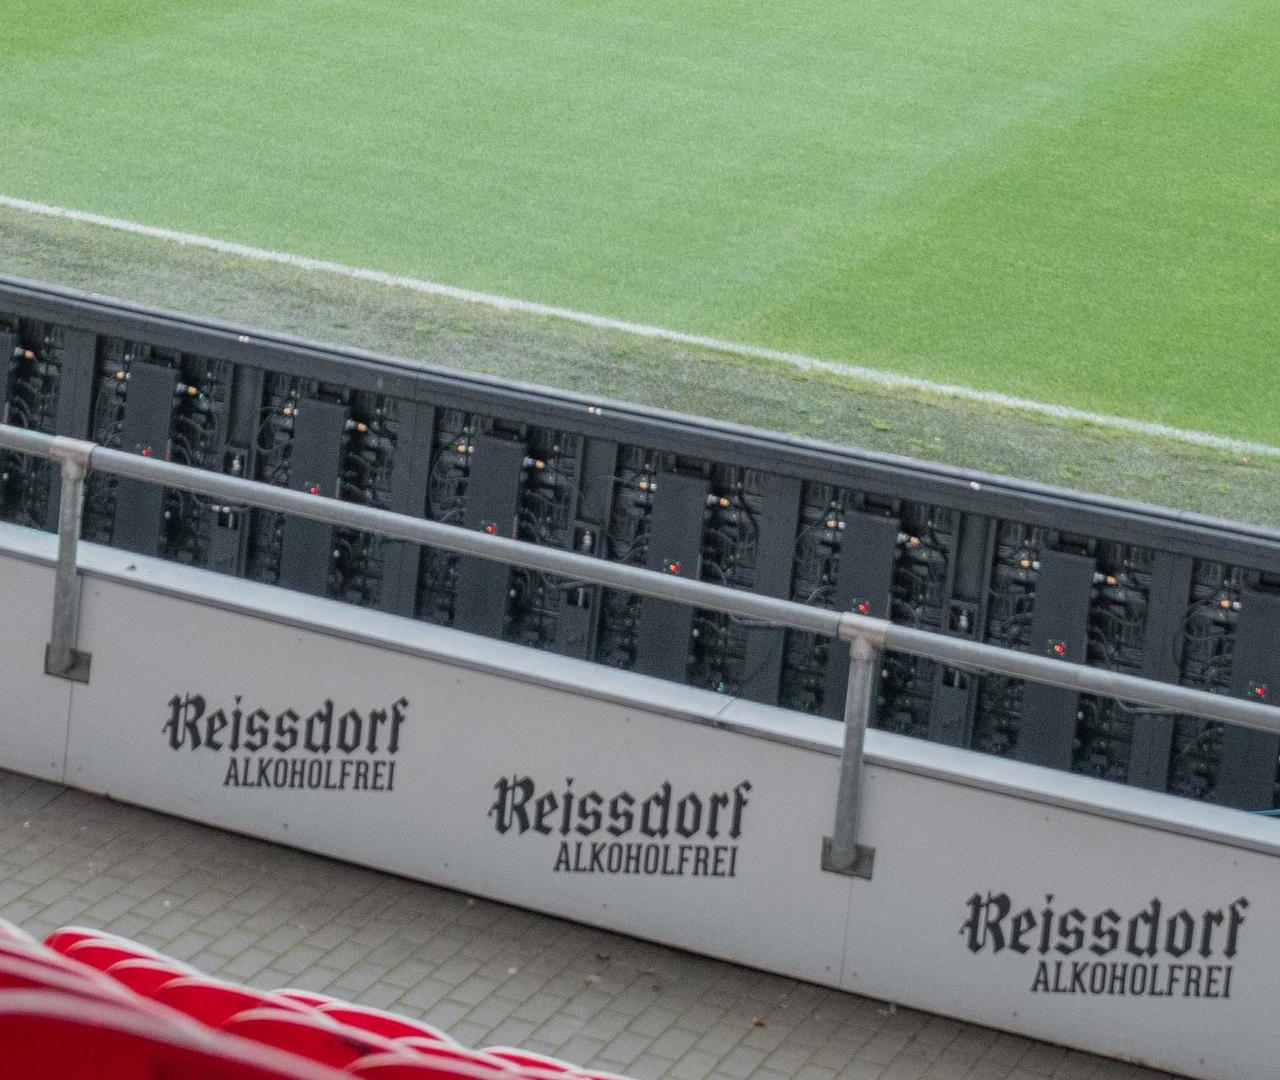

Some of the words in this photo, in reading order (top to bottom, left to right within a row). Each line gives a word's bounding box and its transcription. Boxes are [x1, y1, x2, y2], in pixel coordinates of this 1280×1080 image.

[162, 694, 409, 755] Reissdorf
[223, 757, 396, 792] ALKOHOLFREI
[487, 776, 753, 840] Reissdorf
[553, 841, 738, 878] ALKOHOLFREI
[959, 892, 1250, 960] Reissdorf
[1031, 960, 1233, 999] ALKOHOLFREI
